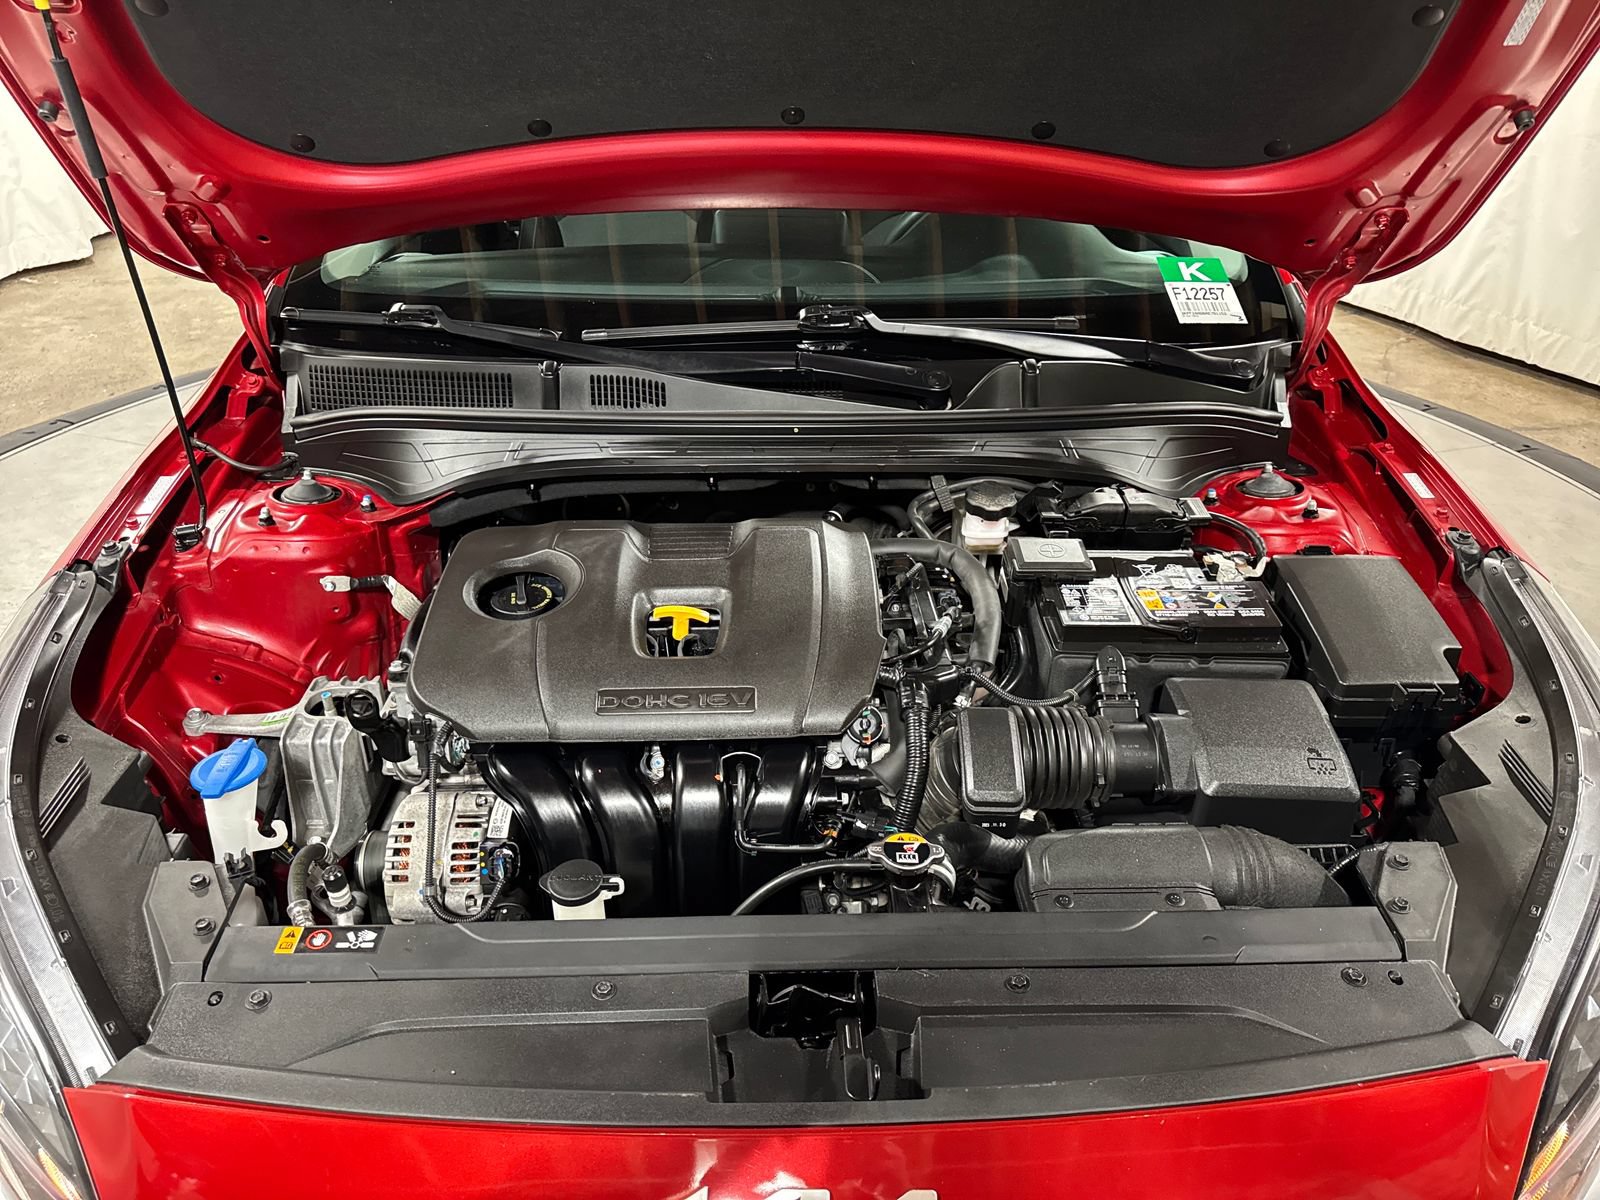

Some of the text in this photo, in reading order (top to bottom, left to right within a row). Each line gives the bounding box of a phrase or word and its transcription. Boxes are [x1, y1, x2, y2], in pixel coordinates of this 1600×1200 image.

[1177, 261, 1212, 281] K
[1171, 287, 1225, 301] F12257
[597, 692, 753, 709] DOHC 16V
